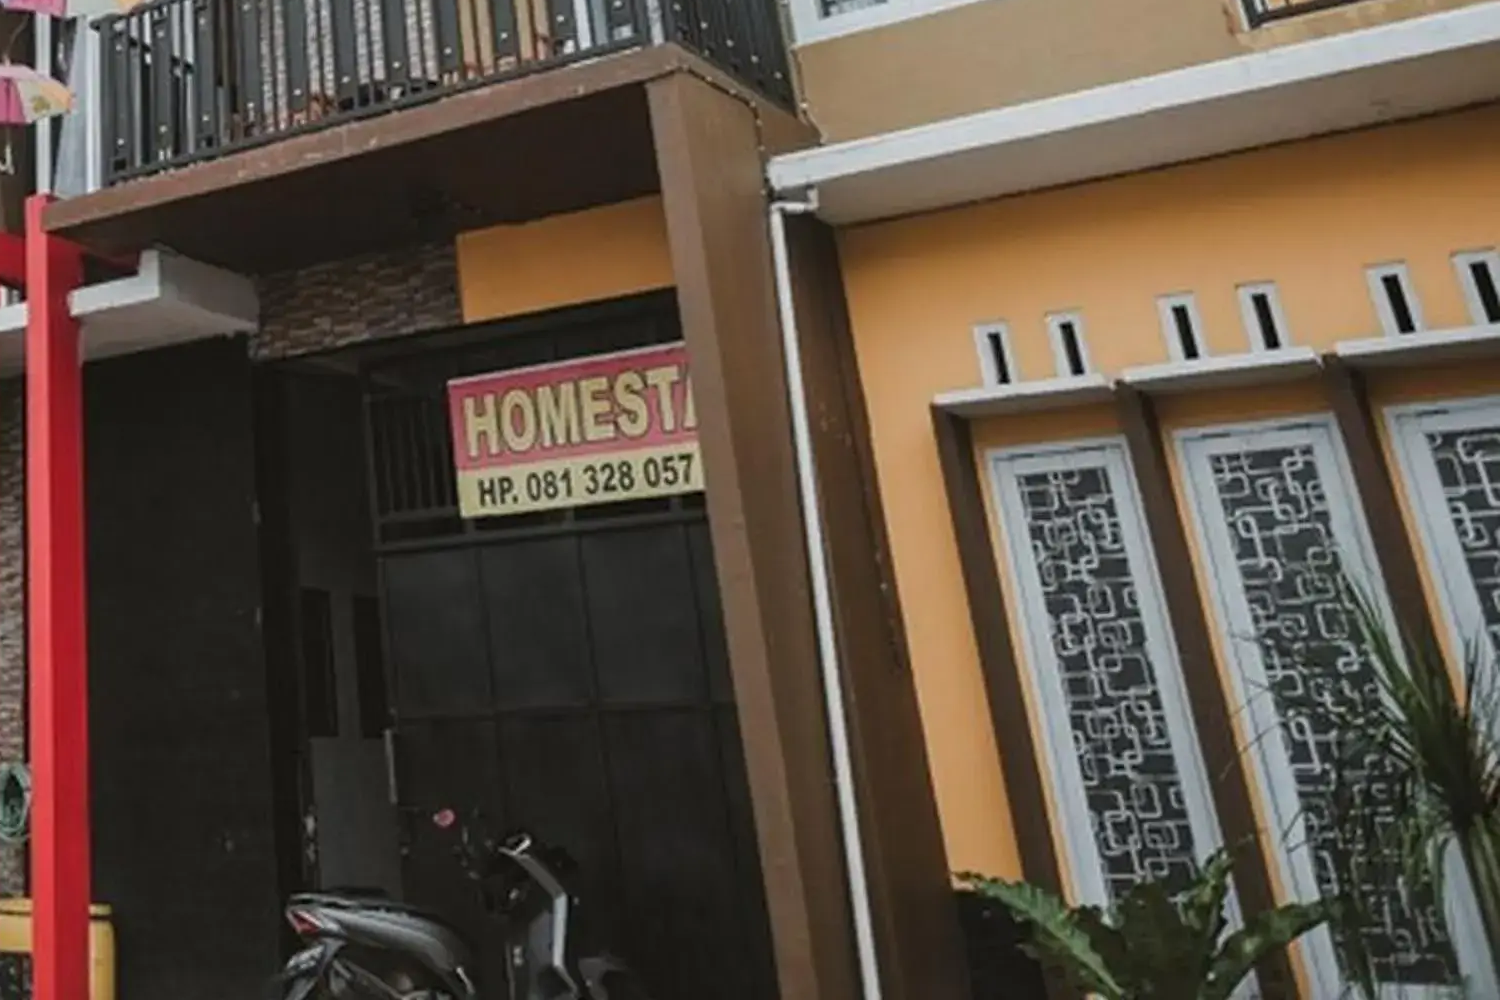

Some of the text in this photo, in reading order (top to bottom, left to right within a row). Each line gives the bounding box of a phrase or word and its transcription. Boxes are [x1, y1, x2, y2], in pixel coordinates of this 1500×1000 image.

[478, 453, 694, 506] HP. 081 328 057
